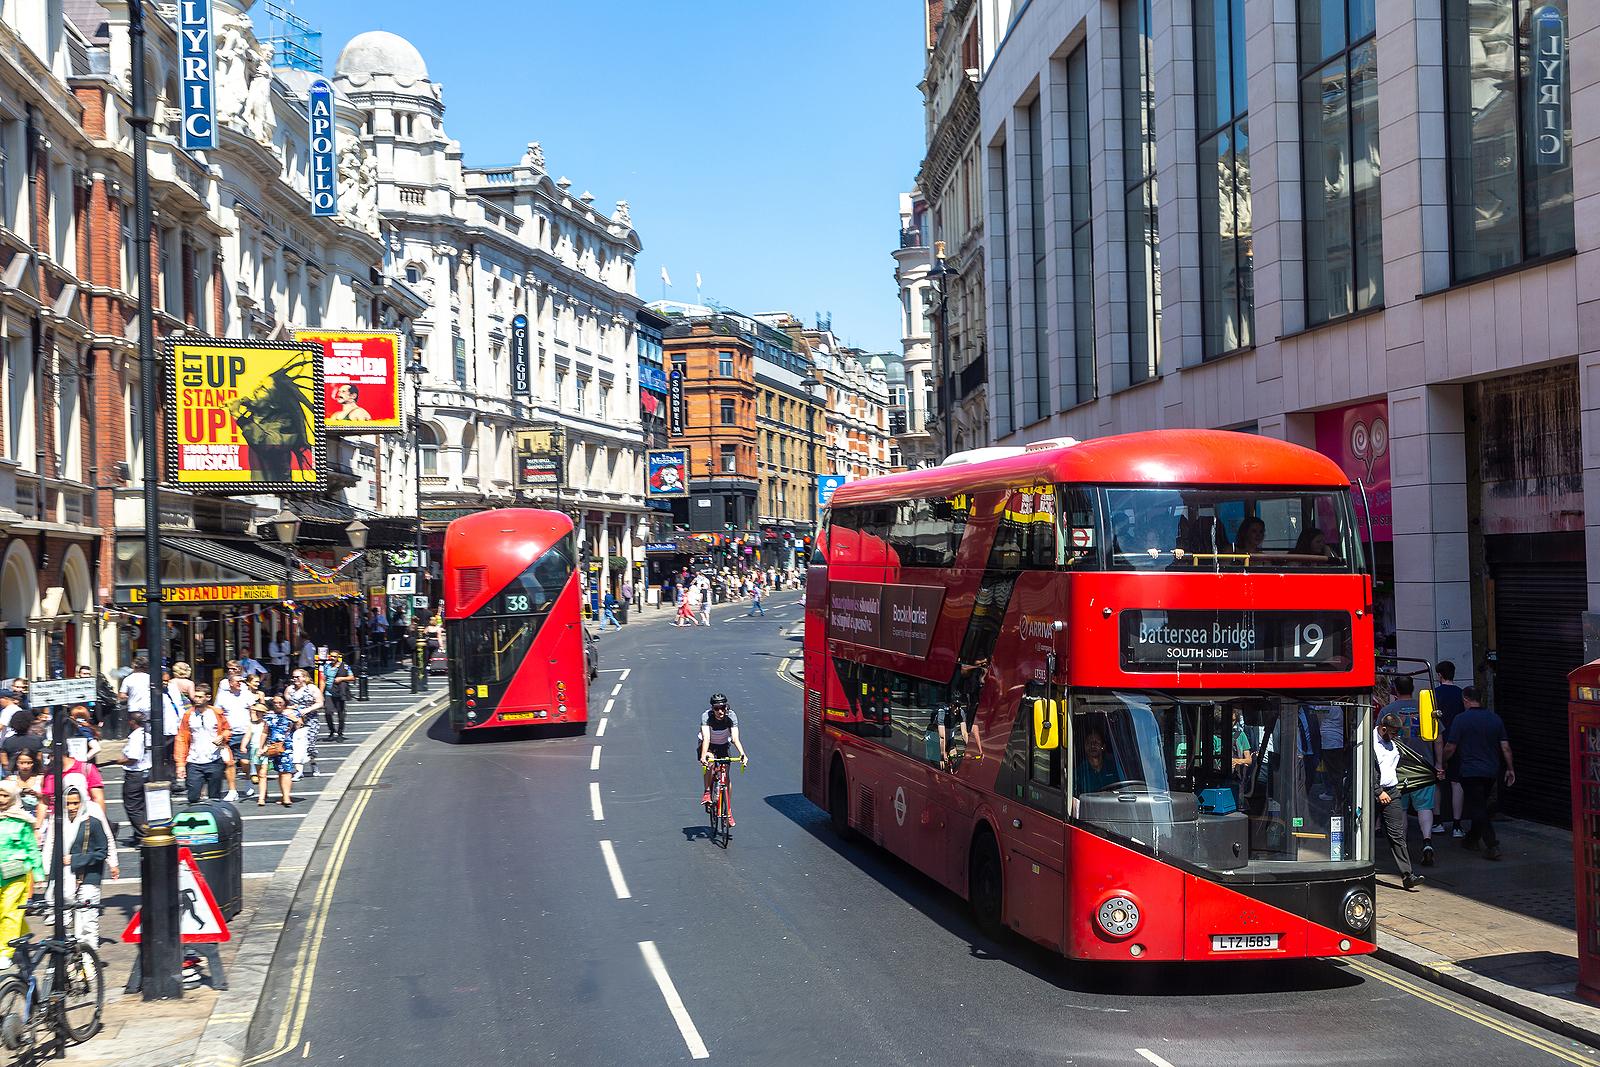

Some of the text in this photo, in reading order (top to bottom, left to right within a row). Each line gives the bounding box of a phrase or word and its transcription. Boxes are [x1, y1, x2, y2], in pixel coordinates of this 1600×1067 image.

[181, 1, 211, 137] LYRIC
[312, 101, 333, 209] APOLLO
[183, 351, 203, 387] GET
[206, 355, 246, 388] UP
[515, 328, 527, 390] GIELGUD
[184, 408, 238, 443] UP!
[183, 454, 243, 471] MUSICAL
[178, 586, 219, 601] STAND
[221, 585, 242, 600] UP!
[507, 595, 528, 611] 38
[1029, 621, 1053, 640] ARRIVA
[1139, 621, 1256, 648] Battersea Bridge
[1293, 623, 1324, 658] 19
[1166, 648, 1229, 658] SOUTH SIDE
[1220, 935, 1271, 949] LTZ 1583
